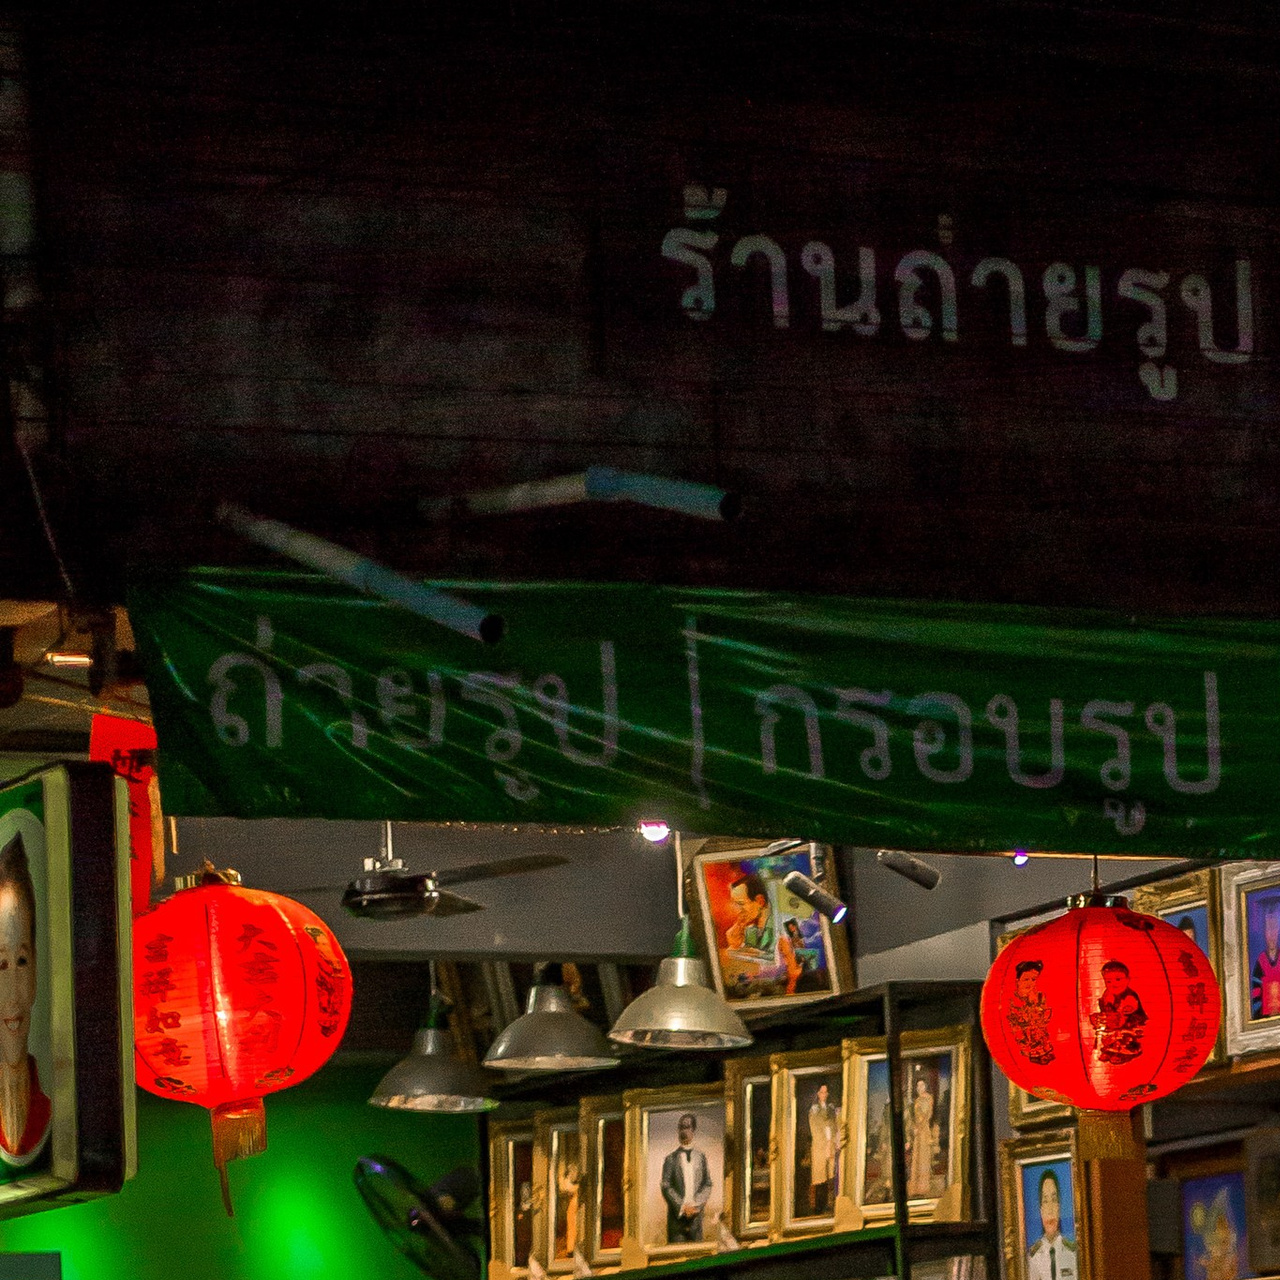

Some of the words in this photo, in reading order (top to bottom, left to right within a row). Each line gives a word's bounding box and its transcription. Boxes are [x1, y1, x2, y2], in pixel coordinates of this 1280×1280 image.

[660, 184, 1253, 401] ร้านถ่ายรูป
[207, 614, 619, 801] ถ่ายรูป
[754, 670, 1221, 835] กรอบรูป
